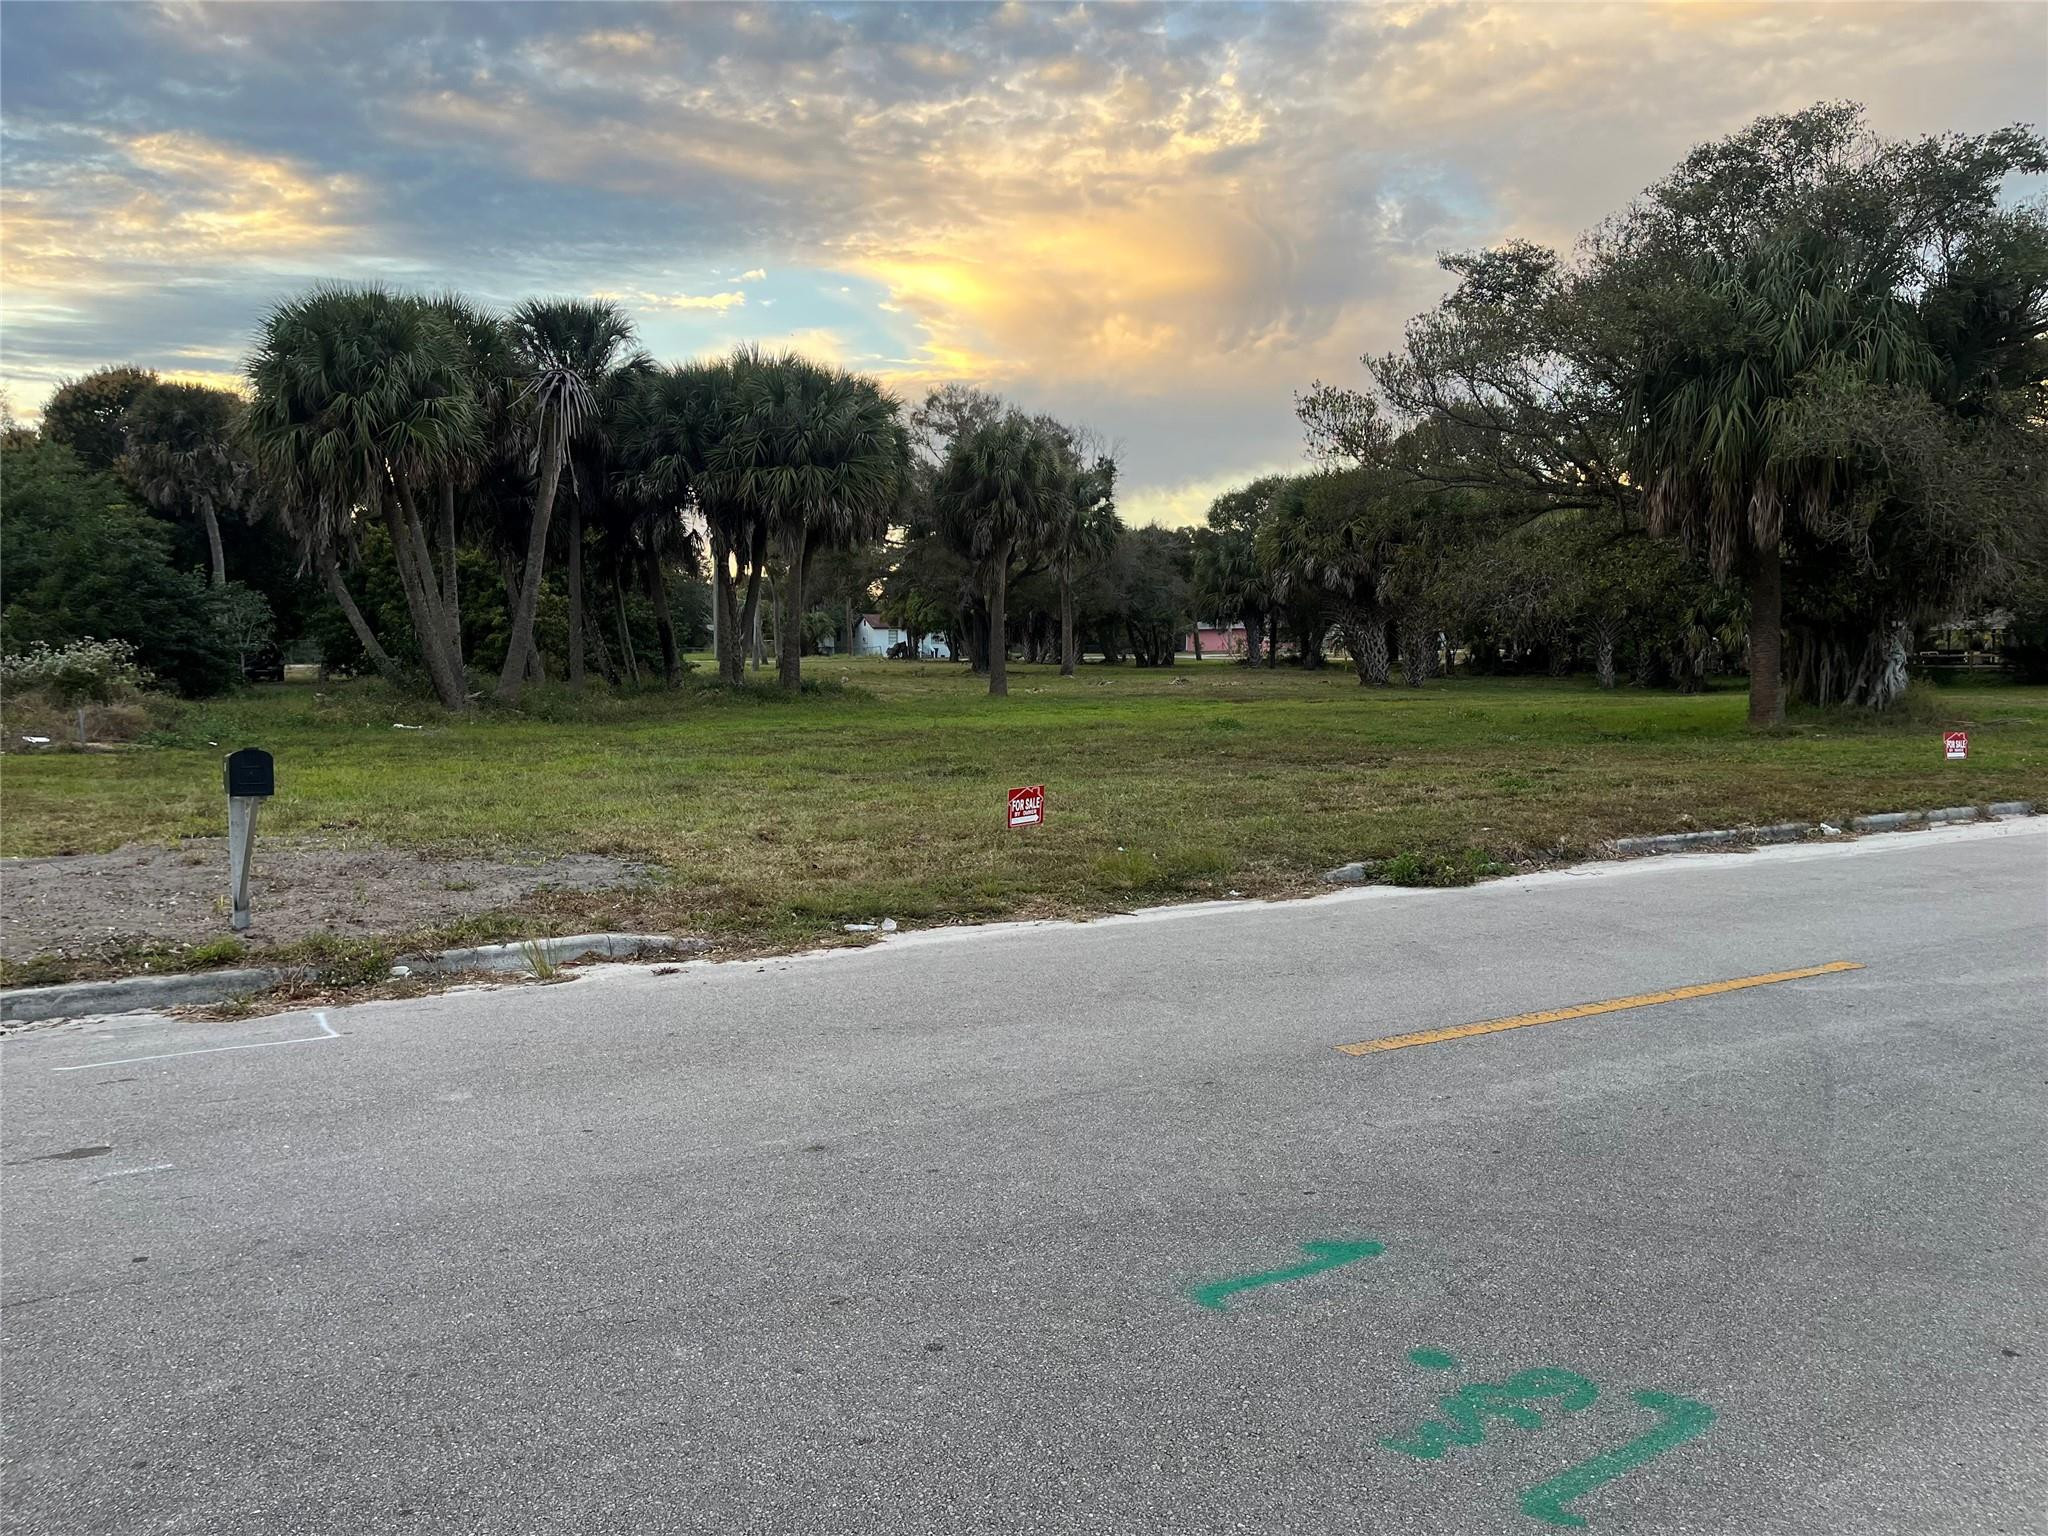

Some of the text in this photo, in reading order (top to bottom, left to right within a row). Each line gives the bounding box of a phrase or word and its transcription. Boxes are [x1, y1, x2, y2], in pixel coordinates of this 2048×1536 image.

[1956, 740, 1966, 748] SALE
[1012, 797, 1040, 812] FOR SALE
